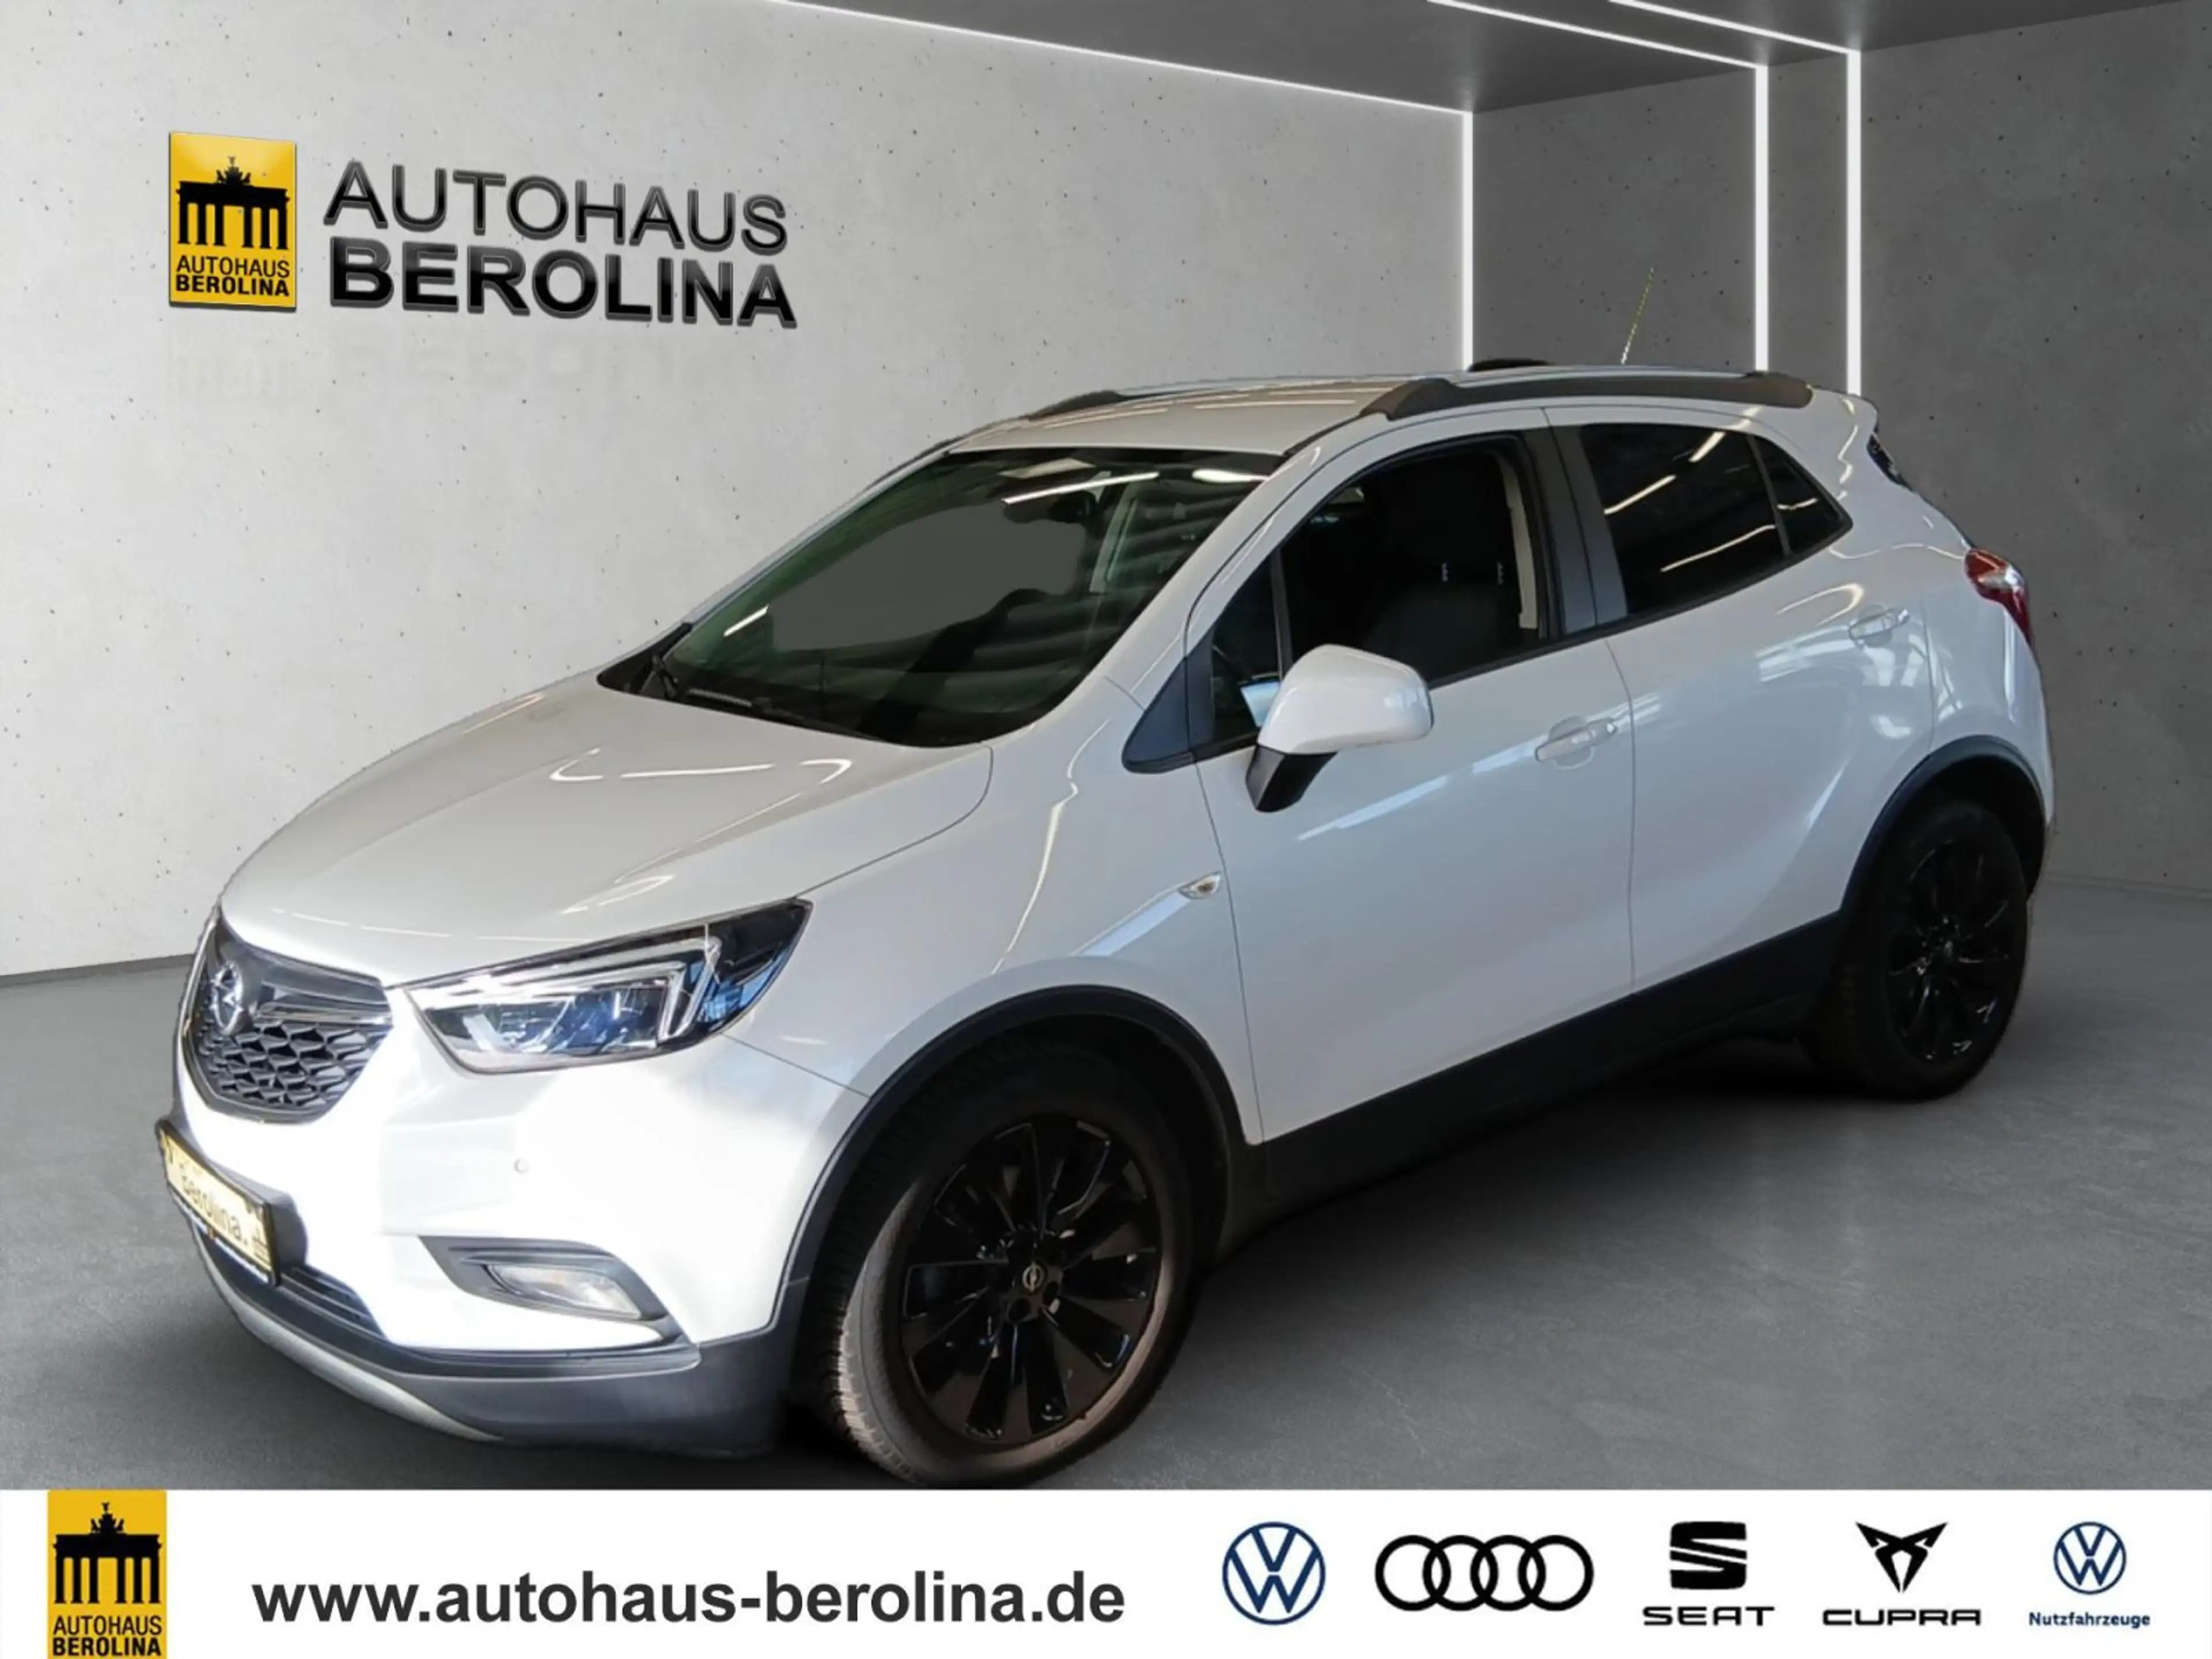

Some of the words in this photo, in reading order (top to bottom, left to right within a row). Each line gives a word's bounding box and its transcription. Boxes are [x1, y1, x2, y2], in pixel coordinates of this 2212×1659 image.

[323, 161, 787, 255] AUTOHAUS
[176, 255, 290, 278] AUTOHAUS
[176, 274, 290, 297] BEROLINA
[329, 236, 797, 329] BEROLINA
